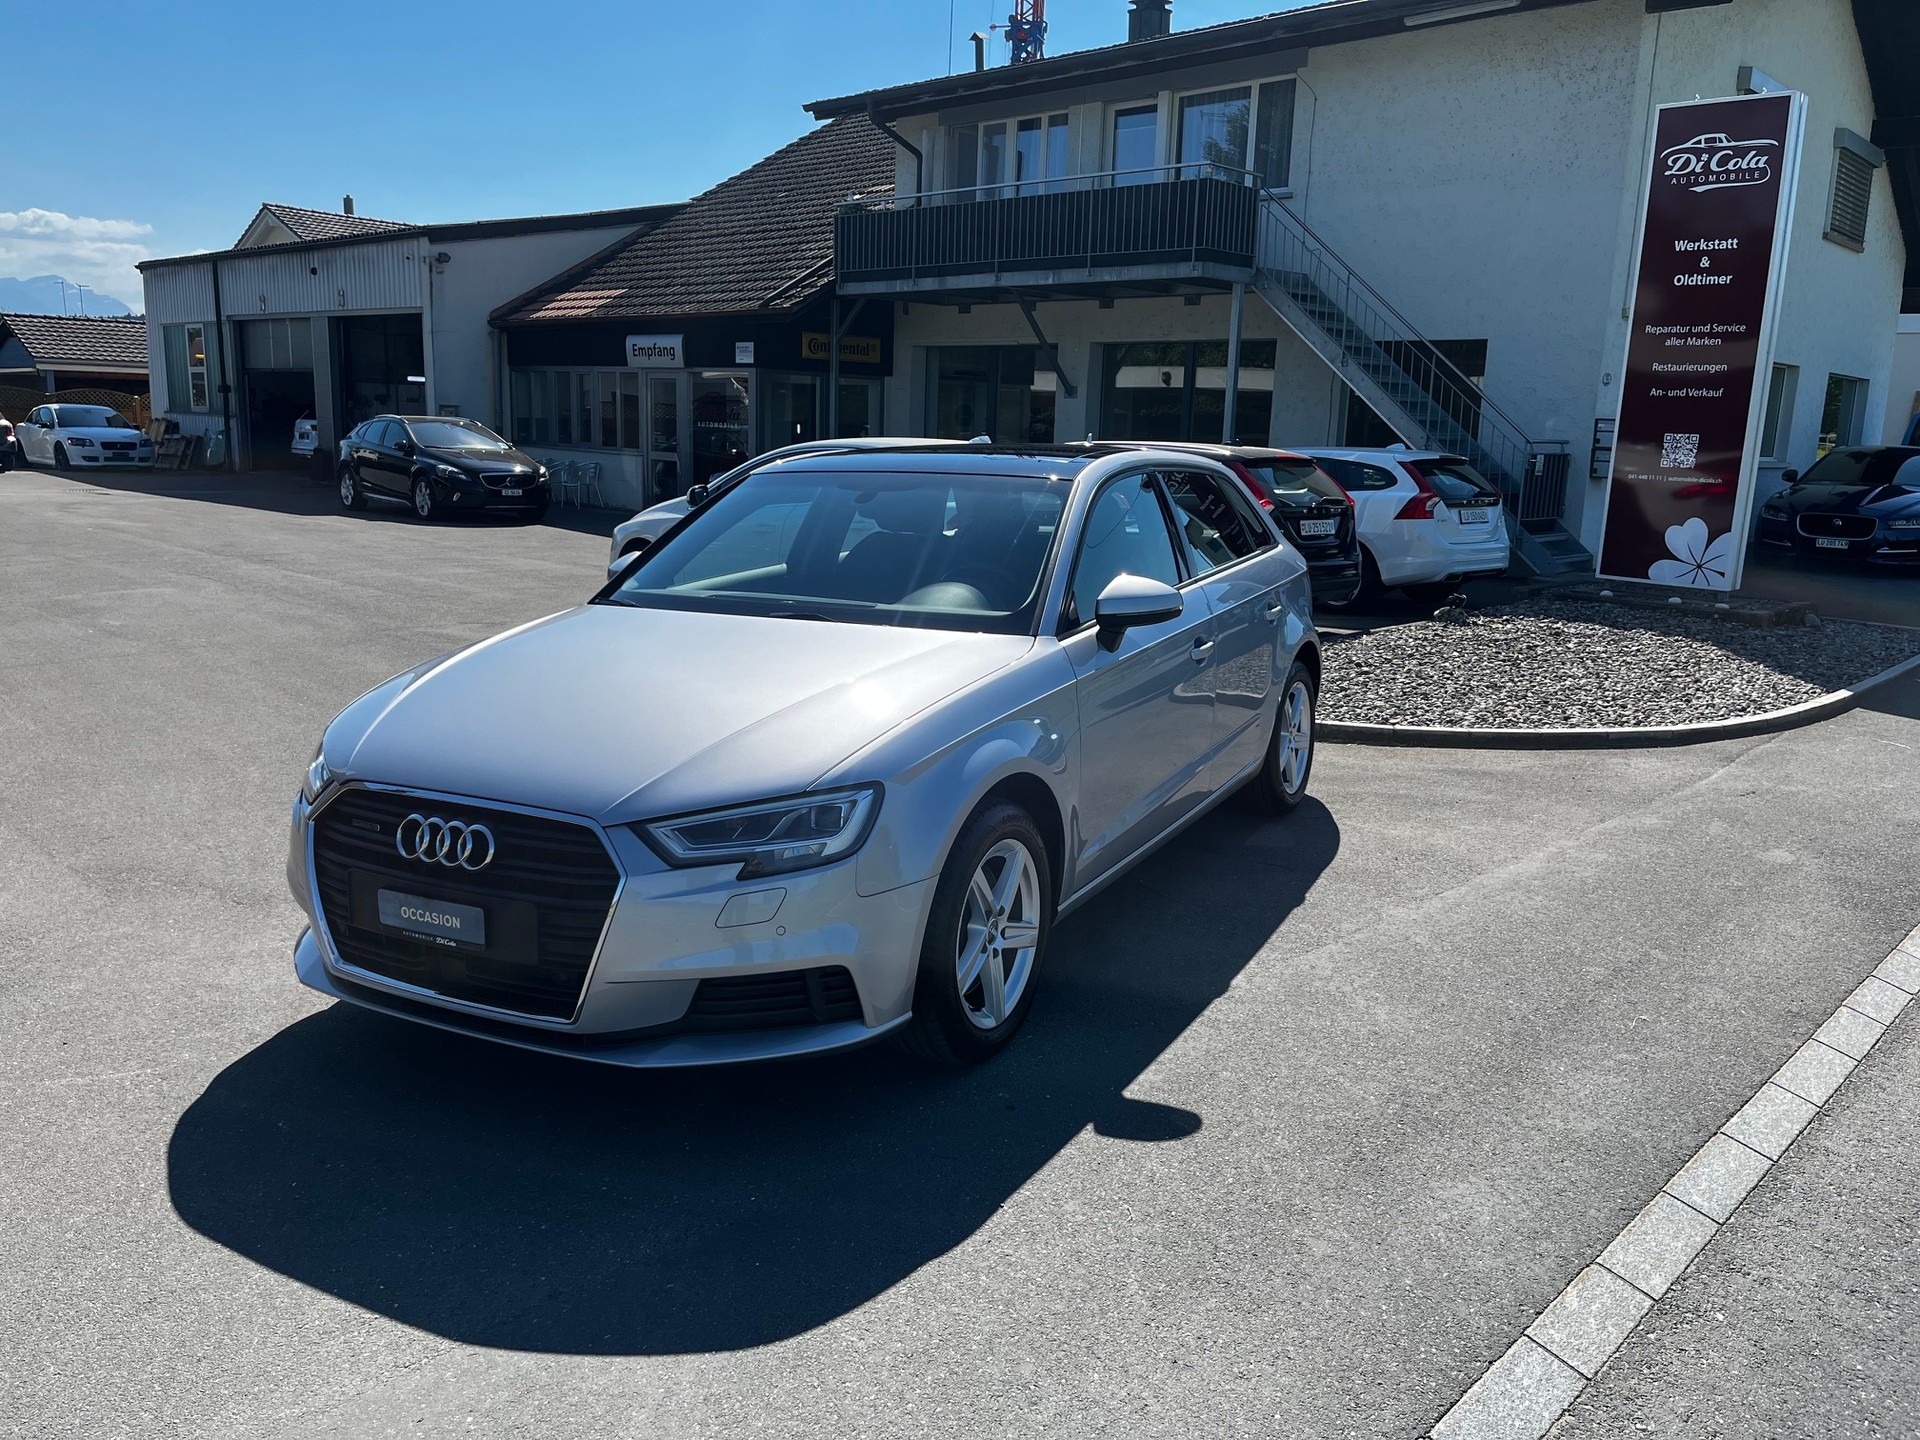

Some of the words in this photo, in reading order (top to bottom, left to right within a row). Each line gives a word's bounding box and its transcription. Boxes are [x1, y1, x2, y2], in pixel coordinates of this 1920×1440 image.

[1670, 170, 1761, 185] AUTOMOBILE
[1674, 237, 1739, 251] Werkstatt
[1699, 256, 1710, 268] &
[1673, 274, 1733, 286] Oldtimer
[1645, 325, 1690, 335] Reparatur
[1692, 324, 1711, 333] und
[1712, 323, 1747, 333] Service
[1665, 337, 1685, 346] aller
[1686, 337, 1722, 346] Marken
[632, 343, 676, 360] Empfang
[1652, 362, 1728, 373] Restaurierungen
[1649, 388, 1666, 397] An-
[1668, 388, 1686, 397] und
[1688, 388, 1724, 397] Verkauf
[697, 421, 738, 429] AUTOMOBILE
[400, 906, 461, 929] OCCASION
